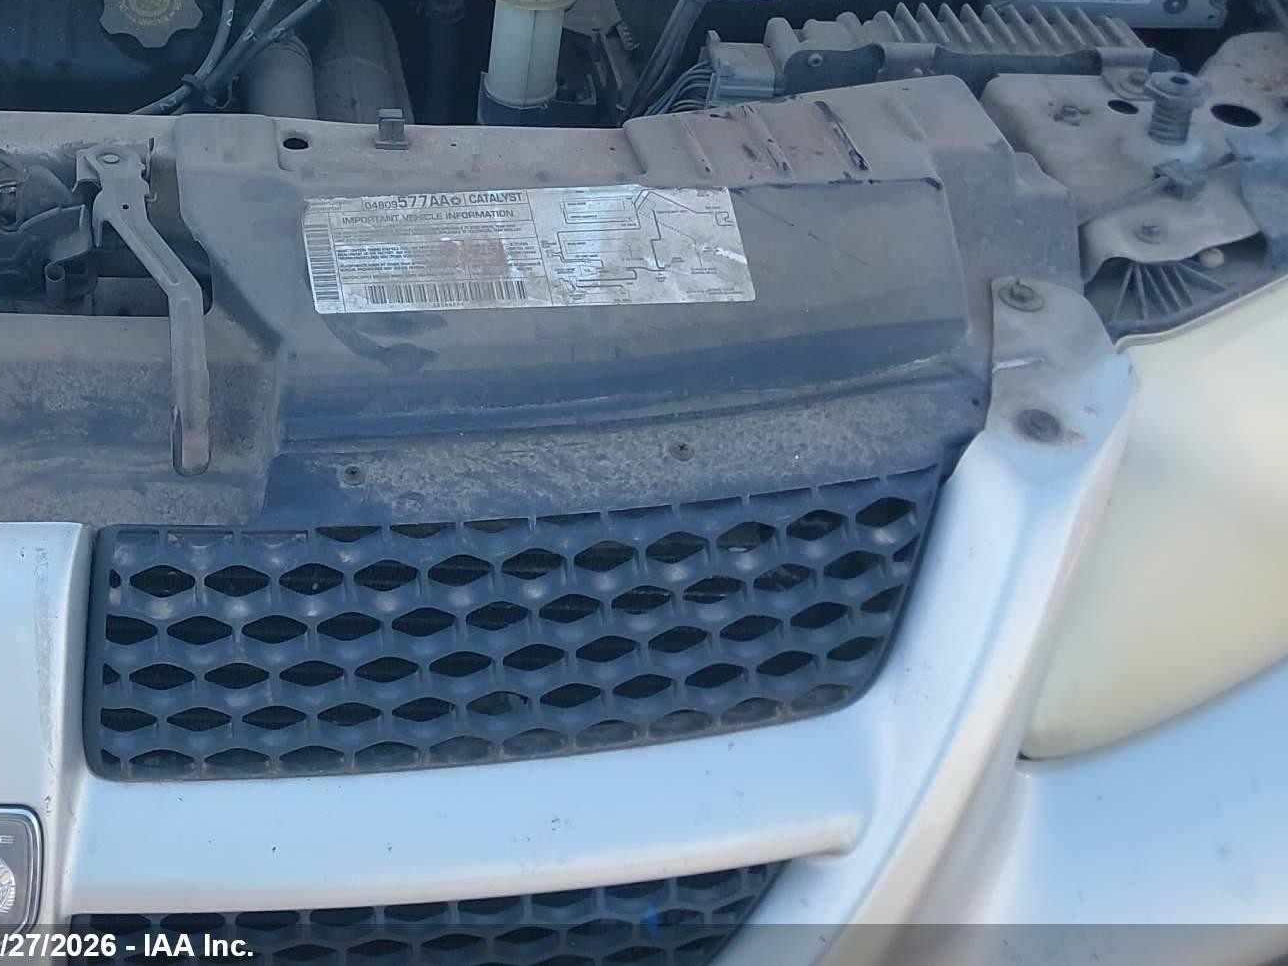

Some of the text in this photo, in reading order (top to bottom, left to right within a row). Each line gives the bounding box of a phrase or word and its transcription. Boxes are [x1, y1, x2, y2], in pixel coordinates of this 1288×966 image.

[468, 192, 523, 205] CATALYST
[342, 209, 515, 225] IMPORTANT VEHICLE INFORMATION
